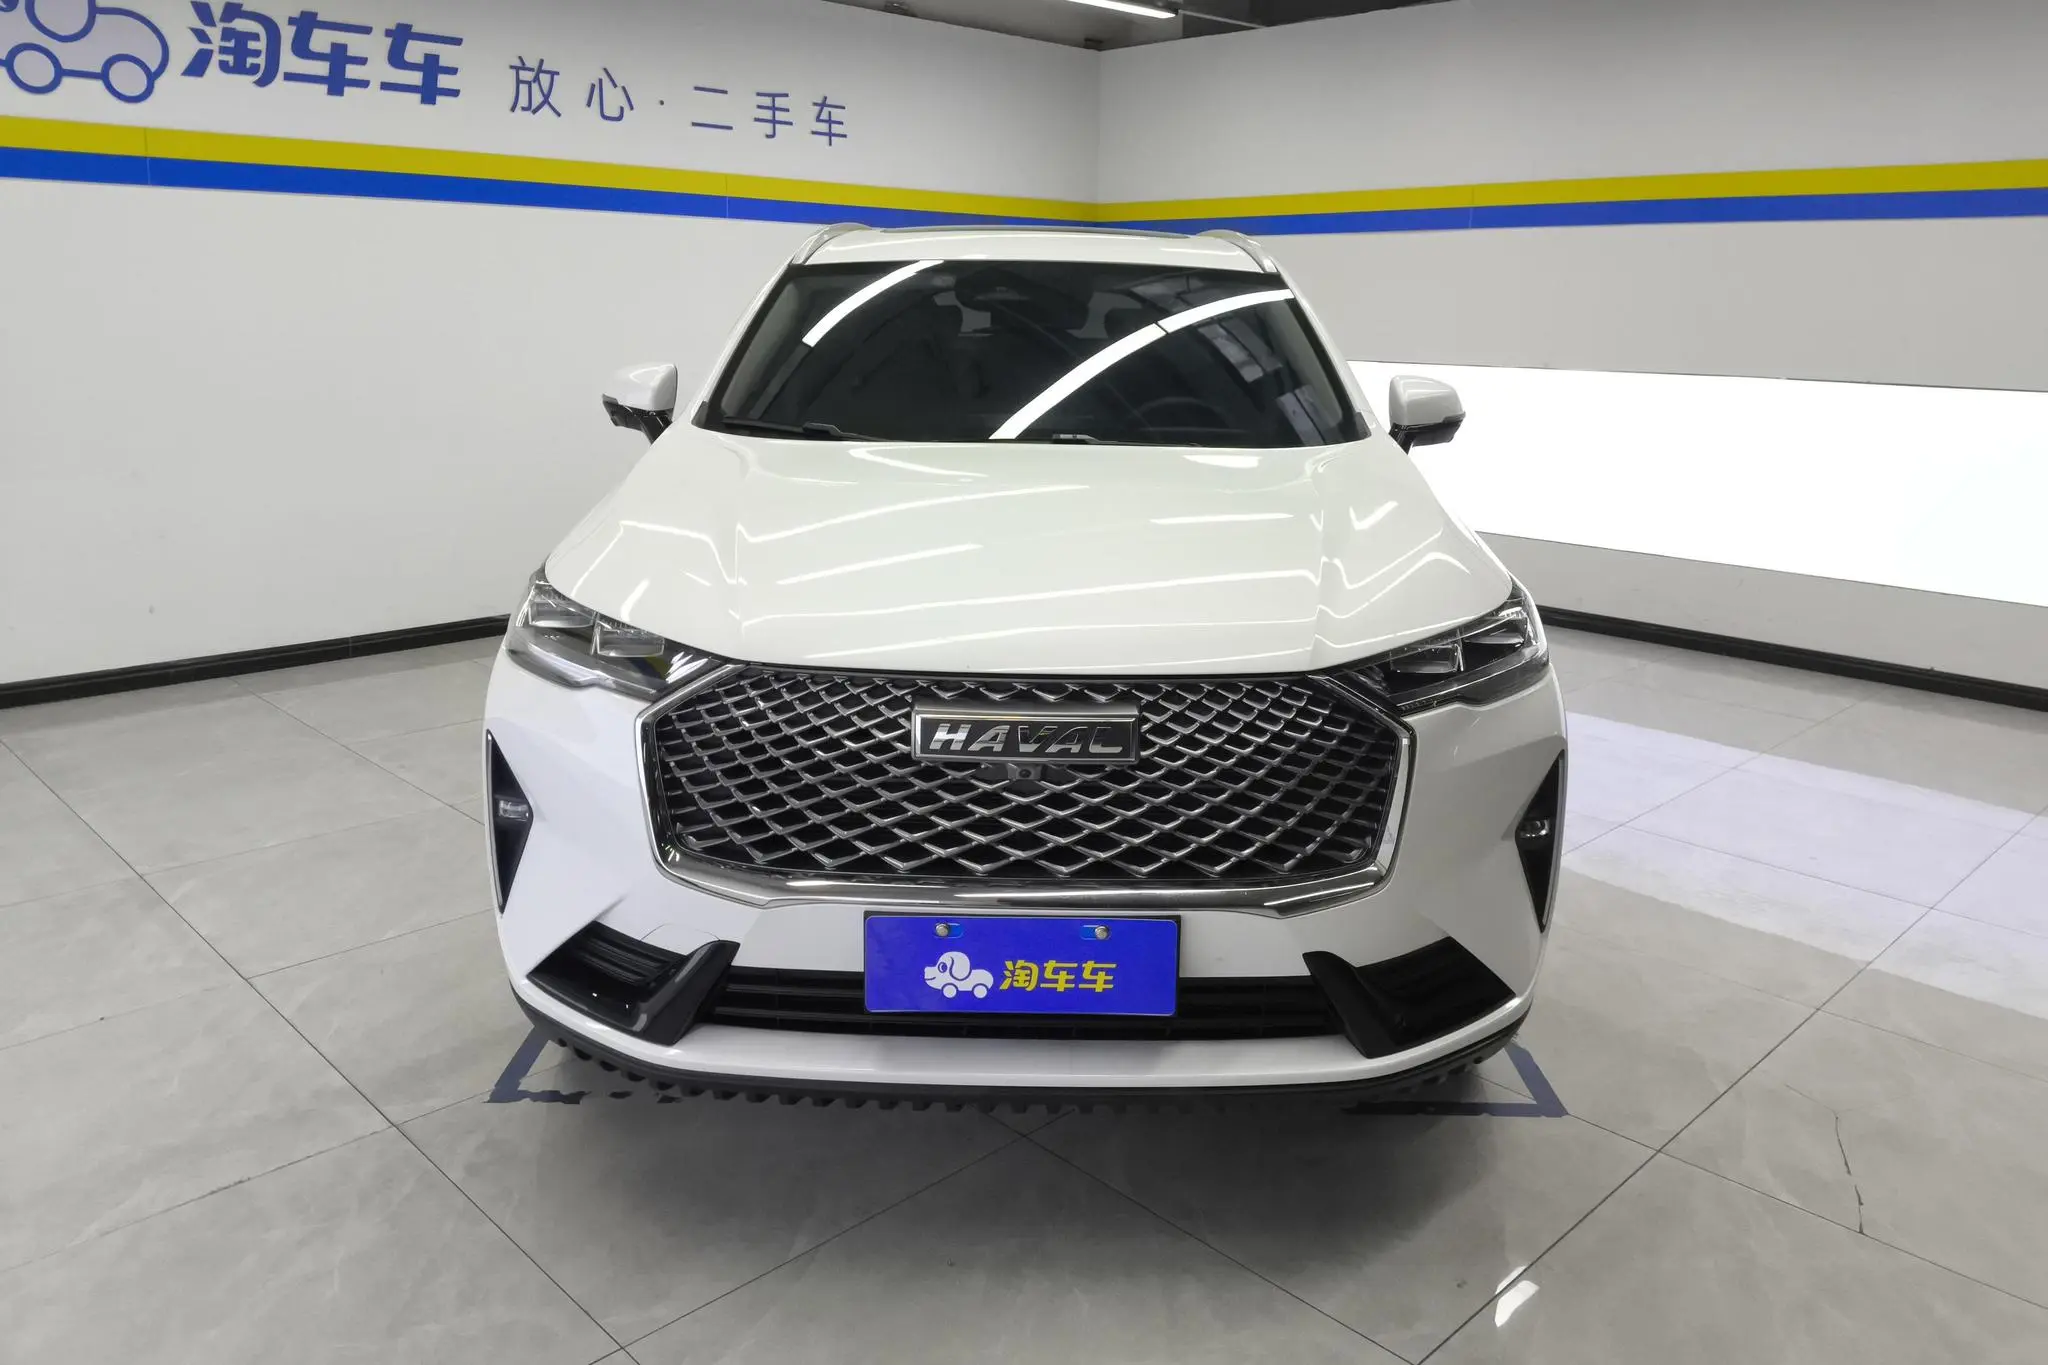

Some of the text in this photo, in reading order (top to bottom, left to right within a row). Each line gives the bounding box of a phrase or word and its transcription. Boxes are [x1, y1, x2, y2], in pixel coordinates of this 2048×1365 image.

[181, 1, 463, 104] 淘车车
[929, 723, 1122, 754] HAVAL
[1000, 959, 1117, 993] 淘车车
